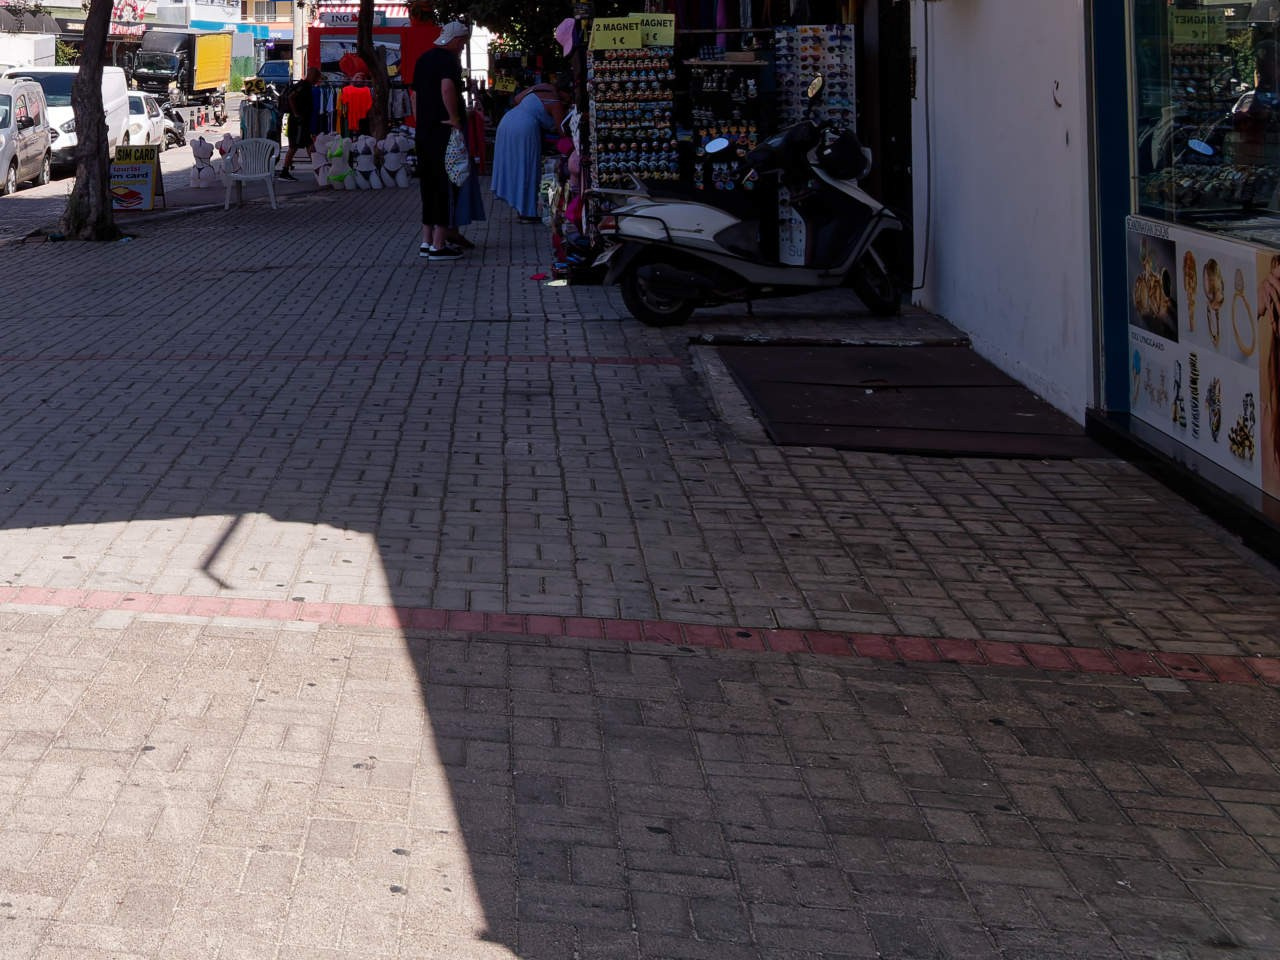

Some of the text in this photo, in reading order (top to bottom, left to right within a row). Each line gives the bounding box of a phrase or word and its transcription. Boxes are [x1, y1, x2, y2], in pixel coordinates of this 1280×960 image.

[331, 15, 350, 23] ING
[595, 21, 640, 32] 2 MAGNET
[117, 148, 156, 161] SIM CARD
